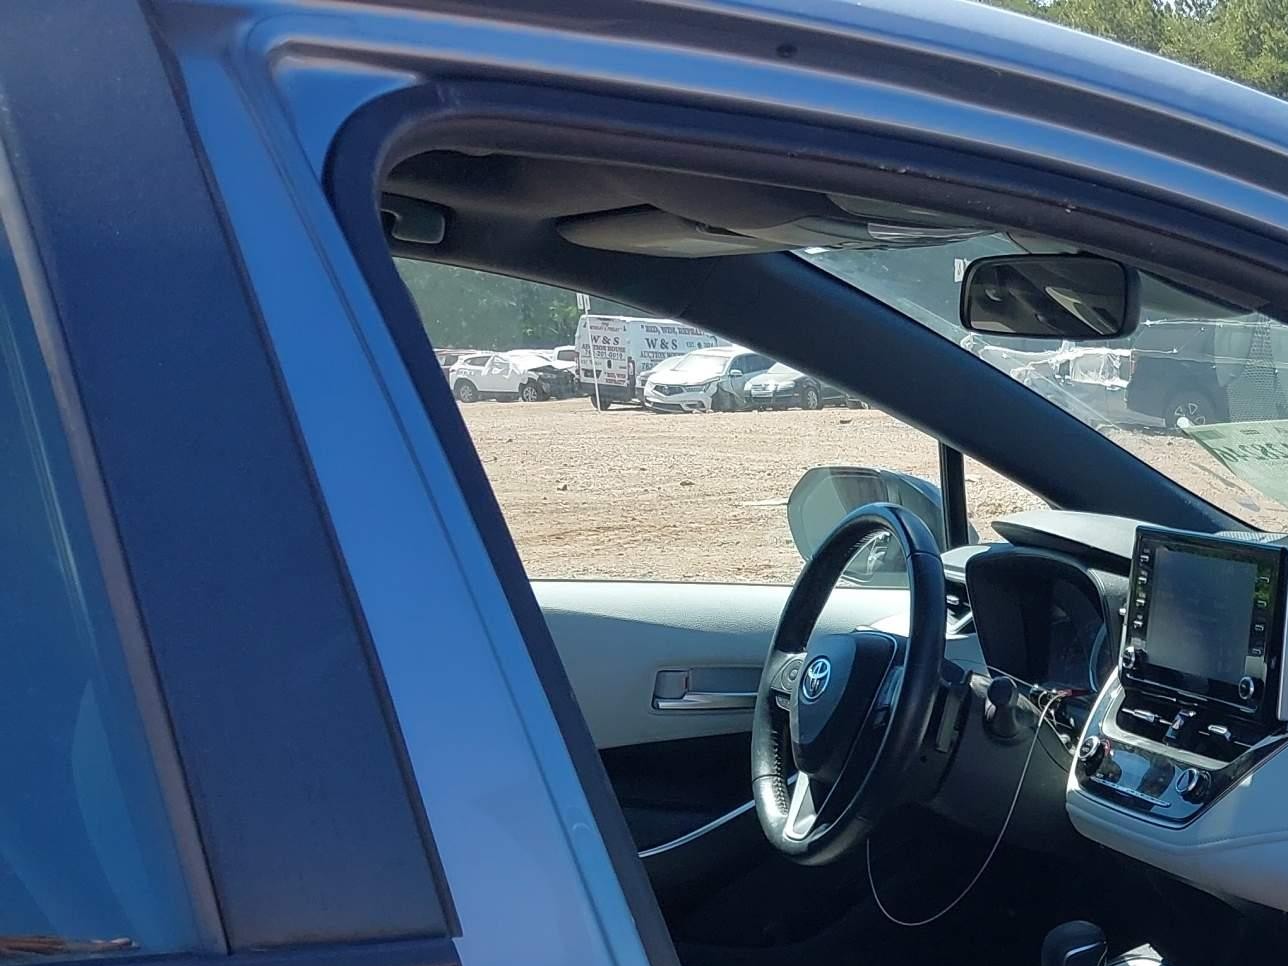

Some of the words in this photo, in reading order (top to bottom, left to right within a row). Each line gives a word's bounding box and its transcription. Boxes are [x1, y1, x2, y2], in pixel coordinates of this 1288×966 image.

[590, 334, 600, 344] W
[602, 335, 612, 345] &
[613, 336, 620, 346] S
[645, 338, 658, 350] W
[660, 338, 672, 350] &
[673, 339, 678, 350] S
